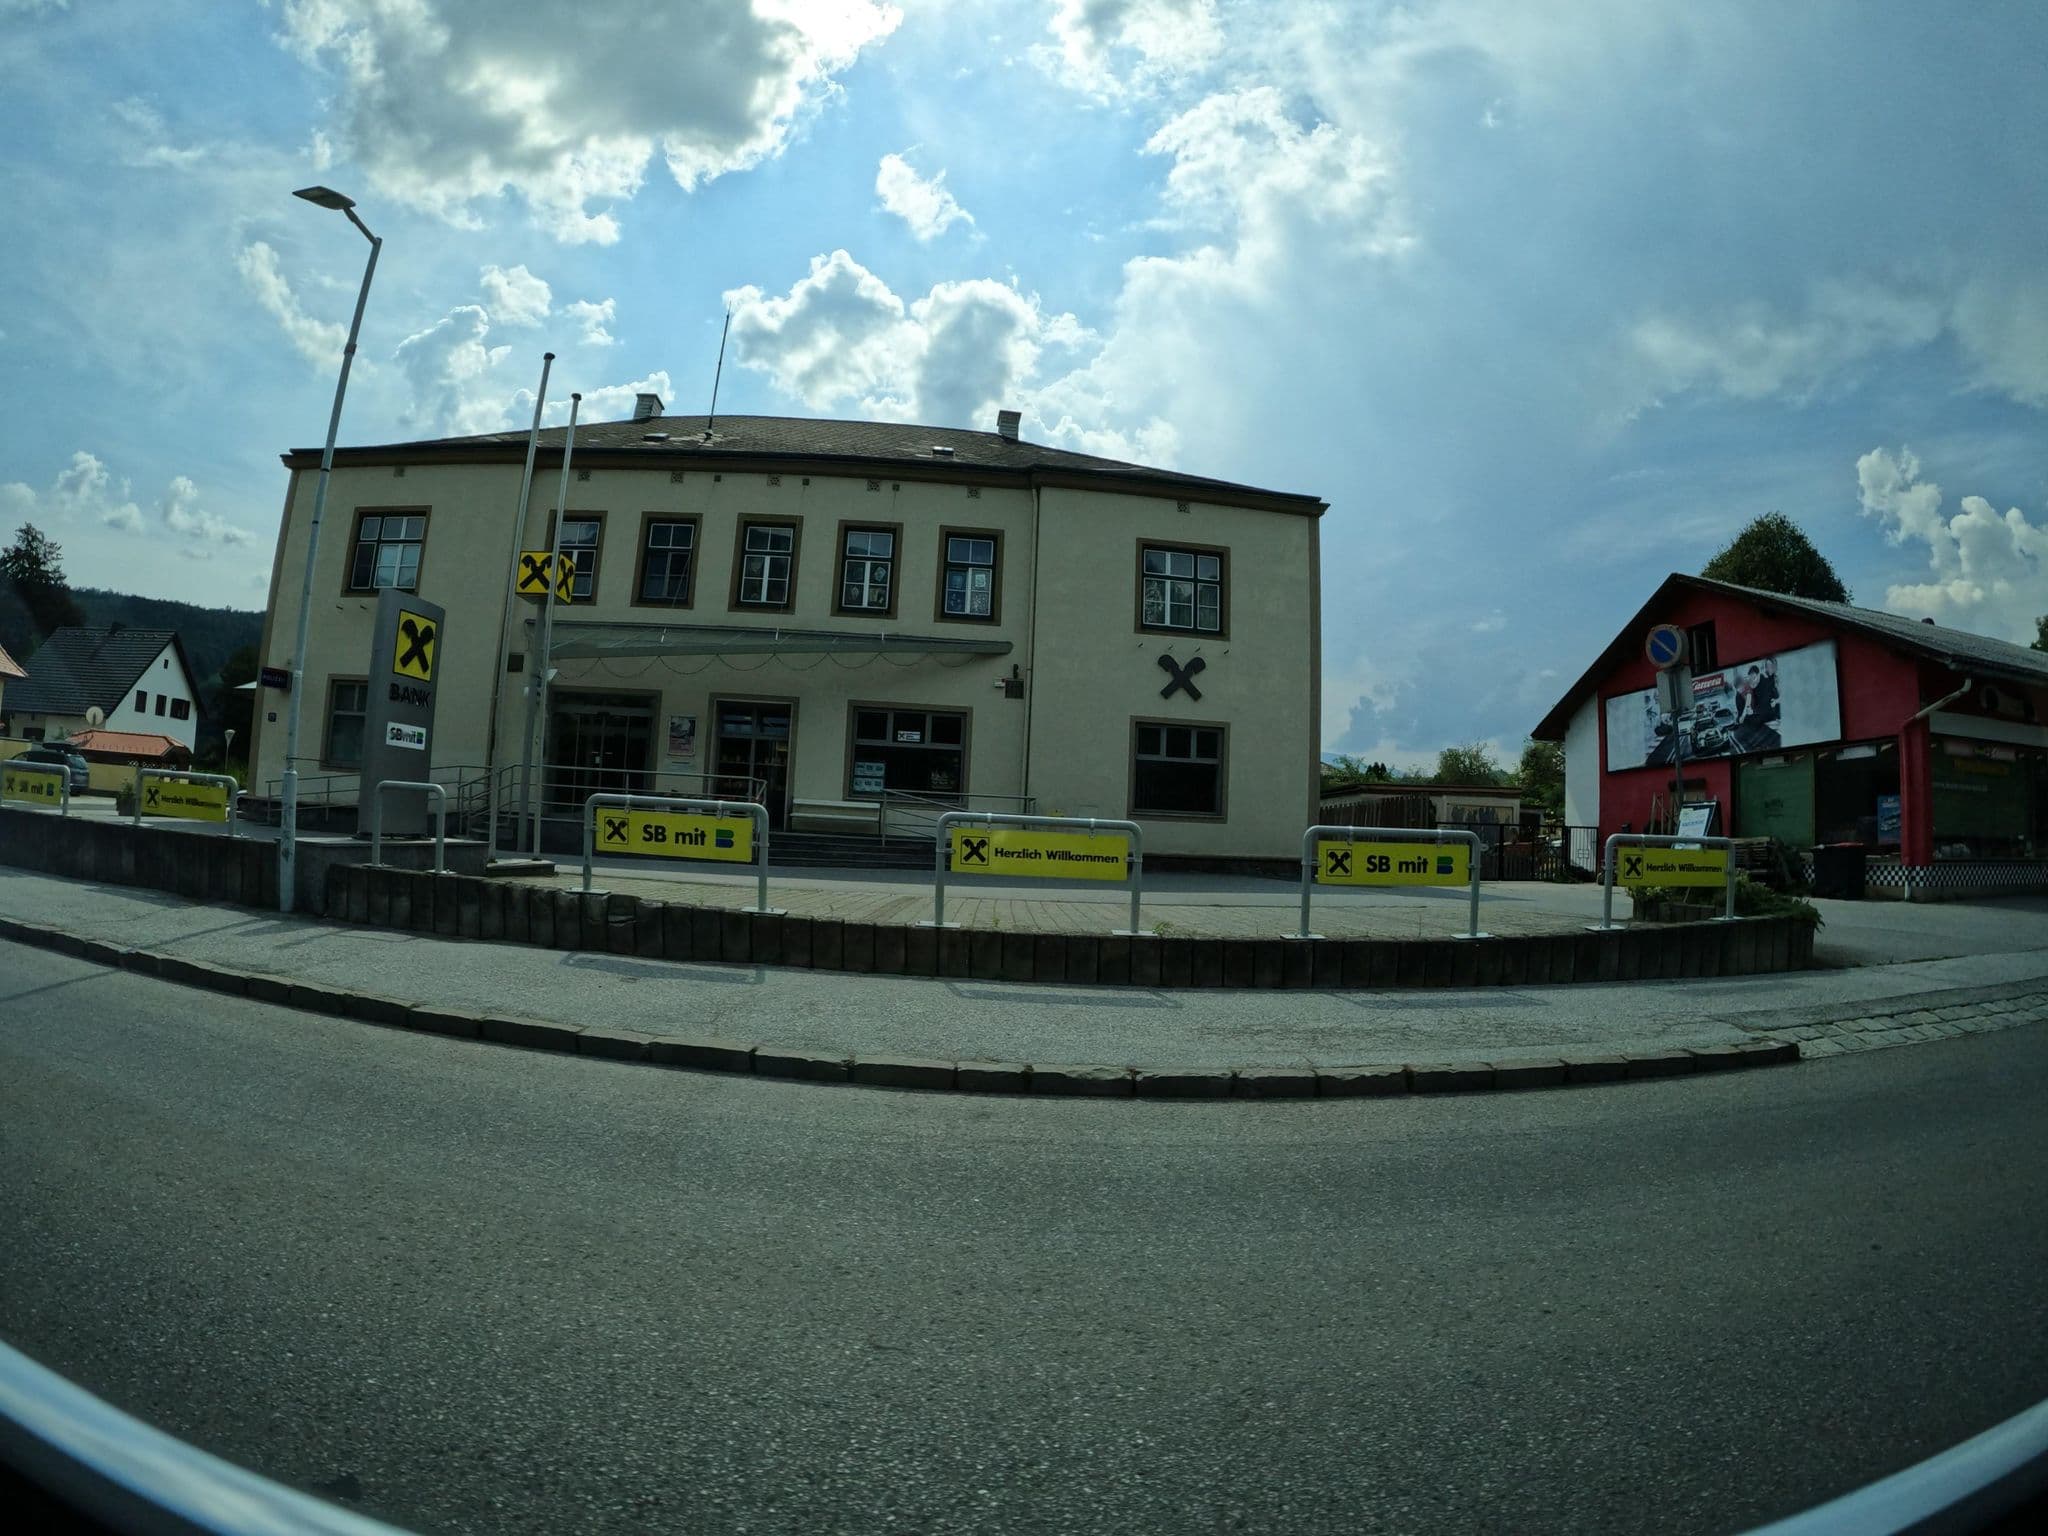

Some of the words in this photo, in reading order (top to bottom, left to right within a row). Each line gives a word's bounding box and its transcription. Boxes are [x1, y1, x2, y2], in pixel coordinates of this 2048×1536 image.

[390, 683, 431, 708] BANK
[390, 727, 402, 740] SB
[402, 731, 416, 743] mit
[642, 824, 667, 843] SB
[674, 827, 706, 846] mit
[994, 847, 1042, 860] Herzlich
[1046, 850, 1119, 864] Willkommen
[1366, 855, 1391, 873] SB
[1398, 856, 1428, 874] mit
[1646, 863, 1676, 873] Herzlich
[1678, 863, 1722, 874] Willkommen
